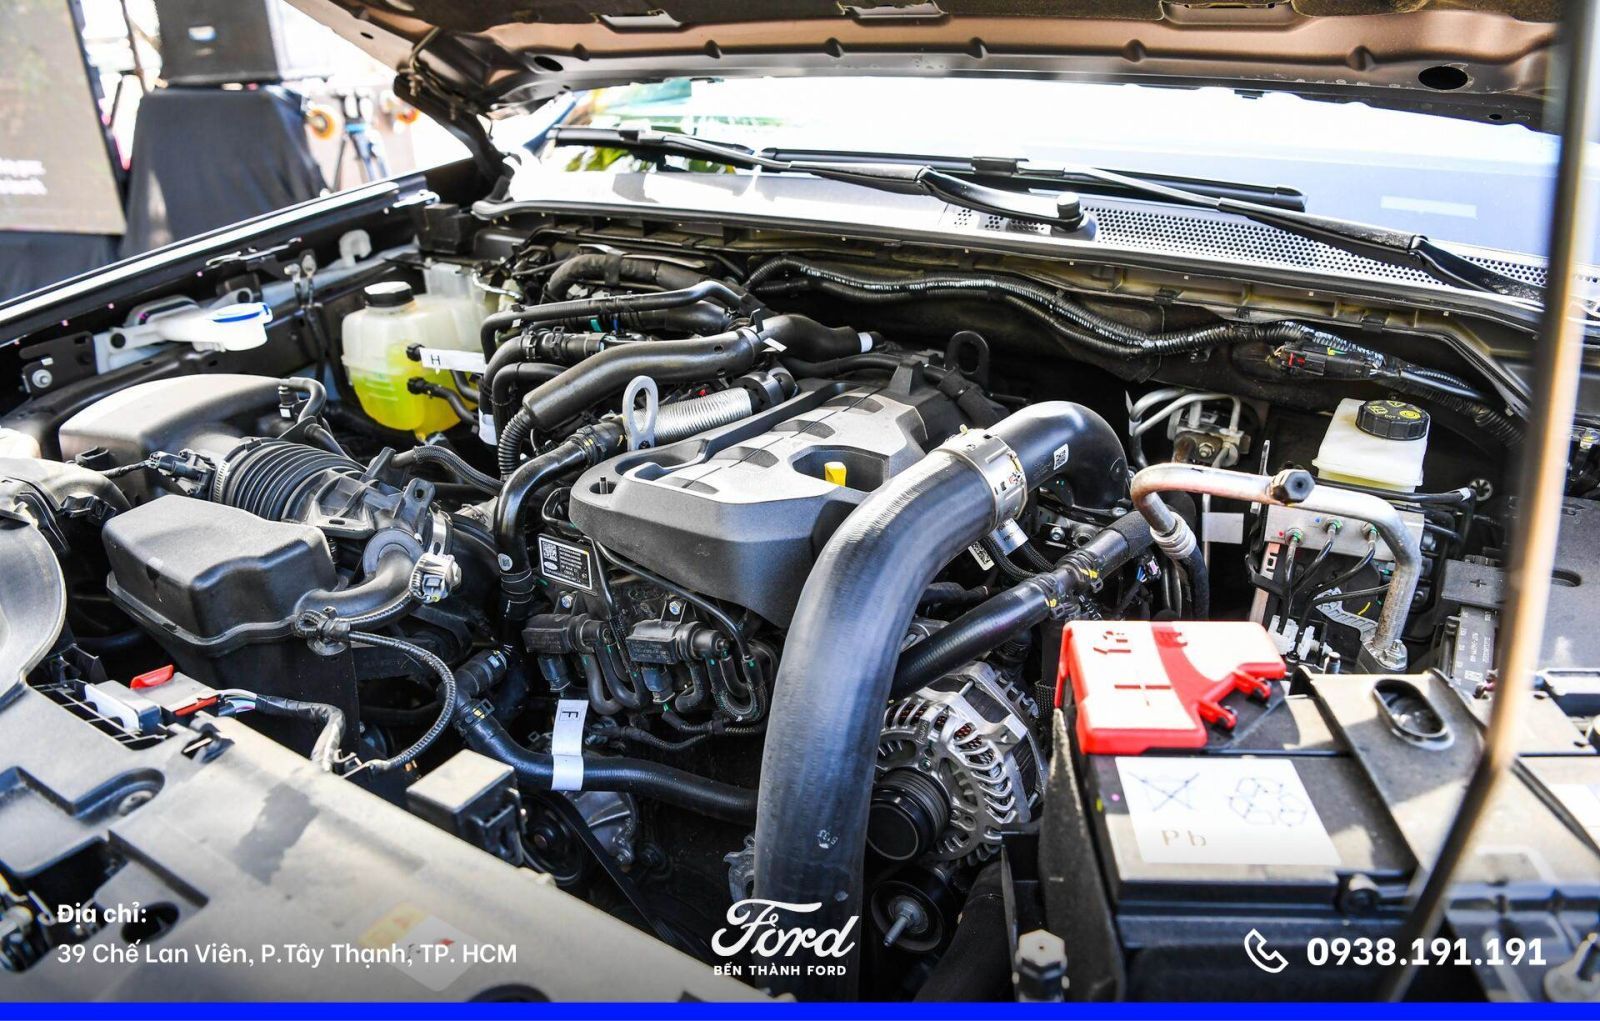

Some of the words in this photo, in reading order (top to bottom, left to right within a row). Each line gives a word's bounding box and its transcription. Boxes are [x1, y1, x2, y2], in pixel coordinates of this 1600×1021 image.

[430, 354, 441, 366] H
[561, 710, 579, 719] F
[1161, 829, 1207, 847] Pb
